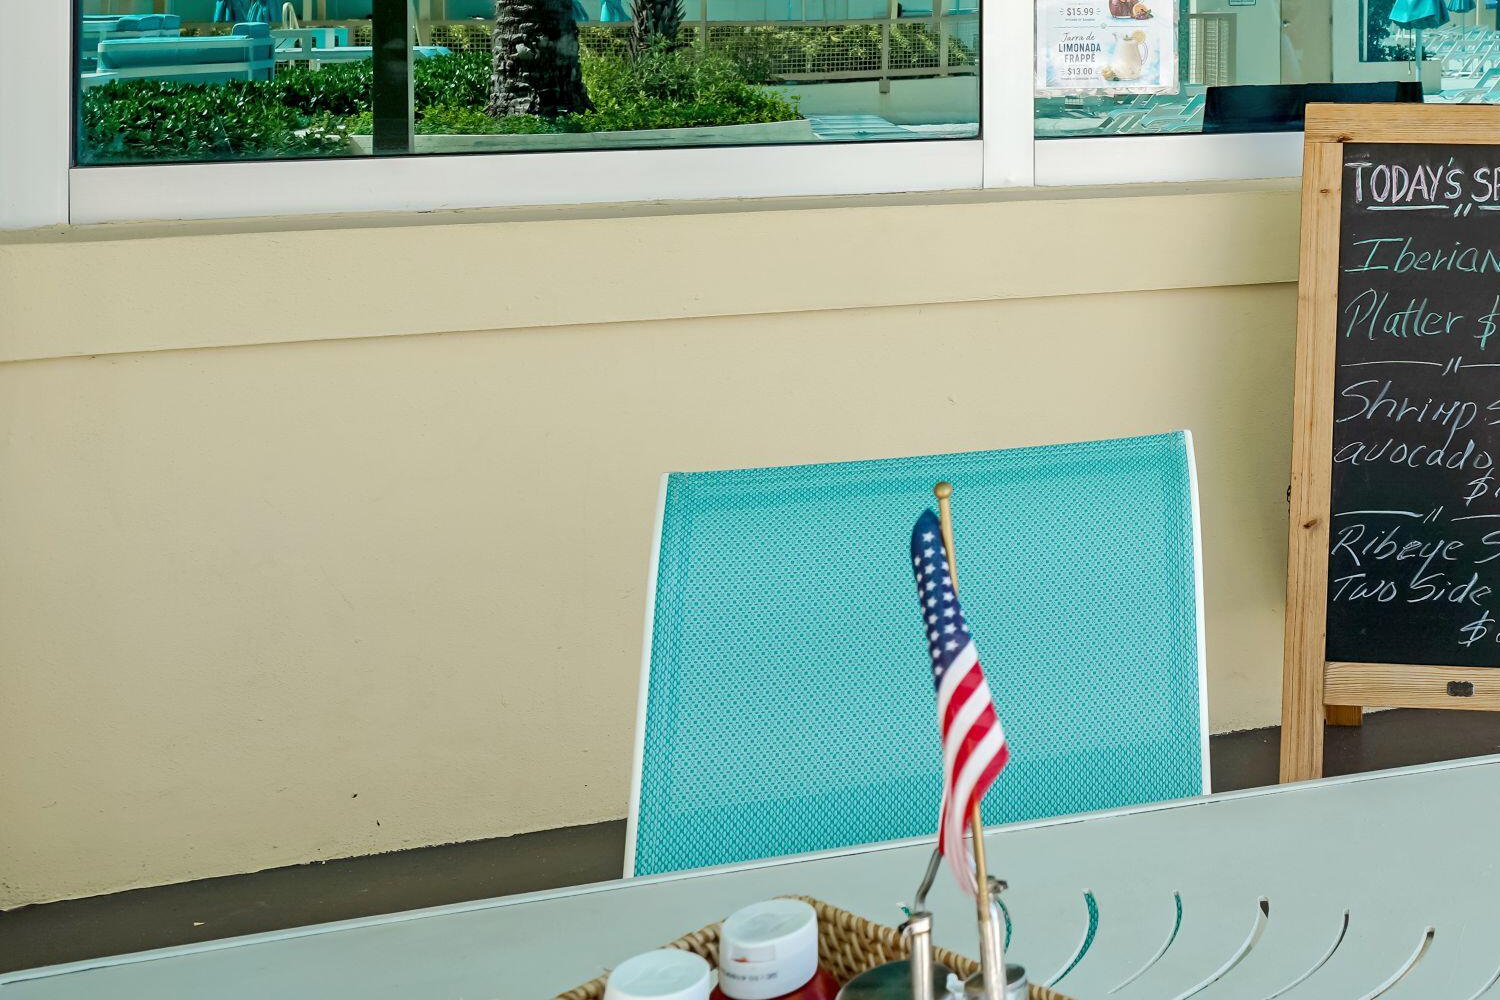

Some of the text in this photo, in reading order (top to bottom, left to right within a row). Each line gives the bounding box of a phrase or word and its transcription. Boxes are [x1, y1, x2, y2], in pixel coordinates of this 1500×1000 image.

[1066, 7, 1094, 17] $15.99
[1061, 31, 1096, 43] Jarra de
[1058, 43, 1102, 53] LIMONADA
[1067, 67, 1093, 76] $13.00
[1344, 288, 1464, 341] Platter
[1333, 439, 1493, 470] avocado
[1331, 524, 1464, 588] Ribeye
[1332, 572, 1493, 606] Two Side
